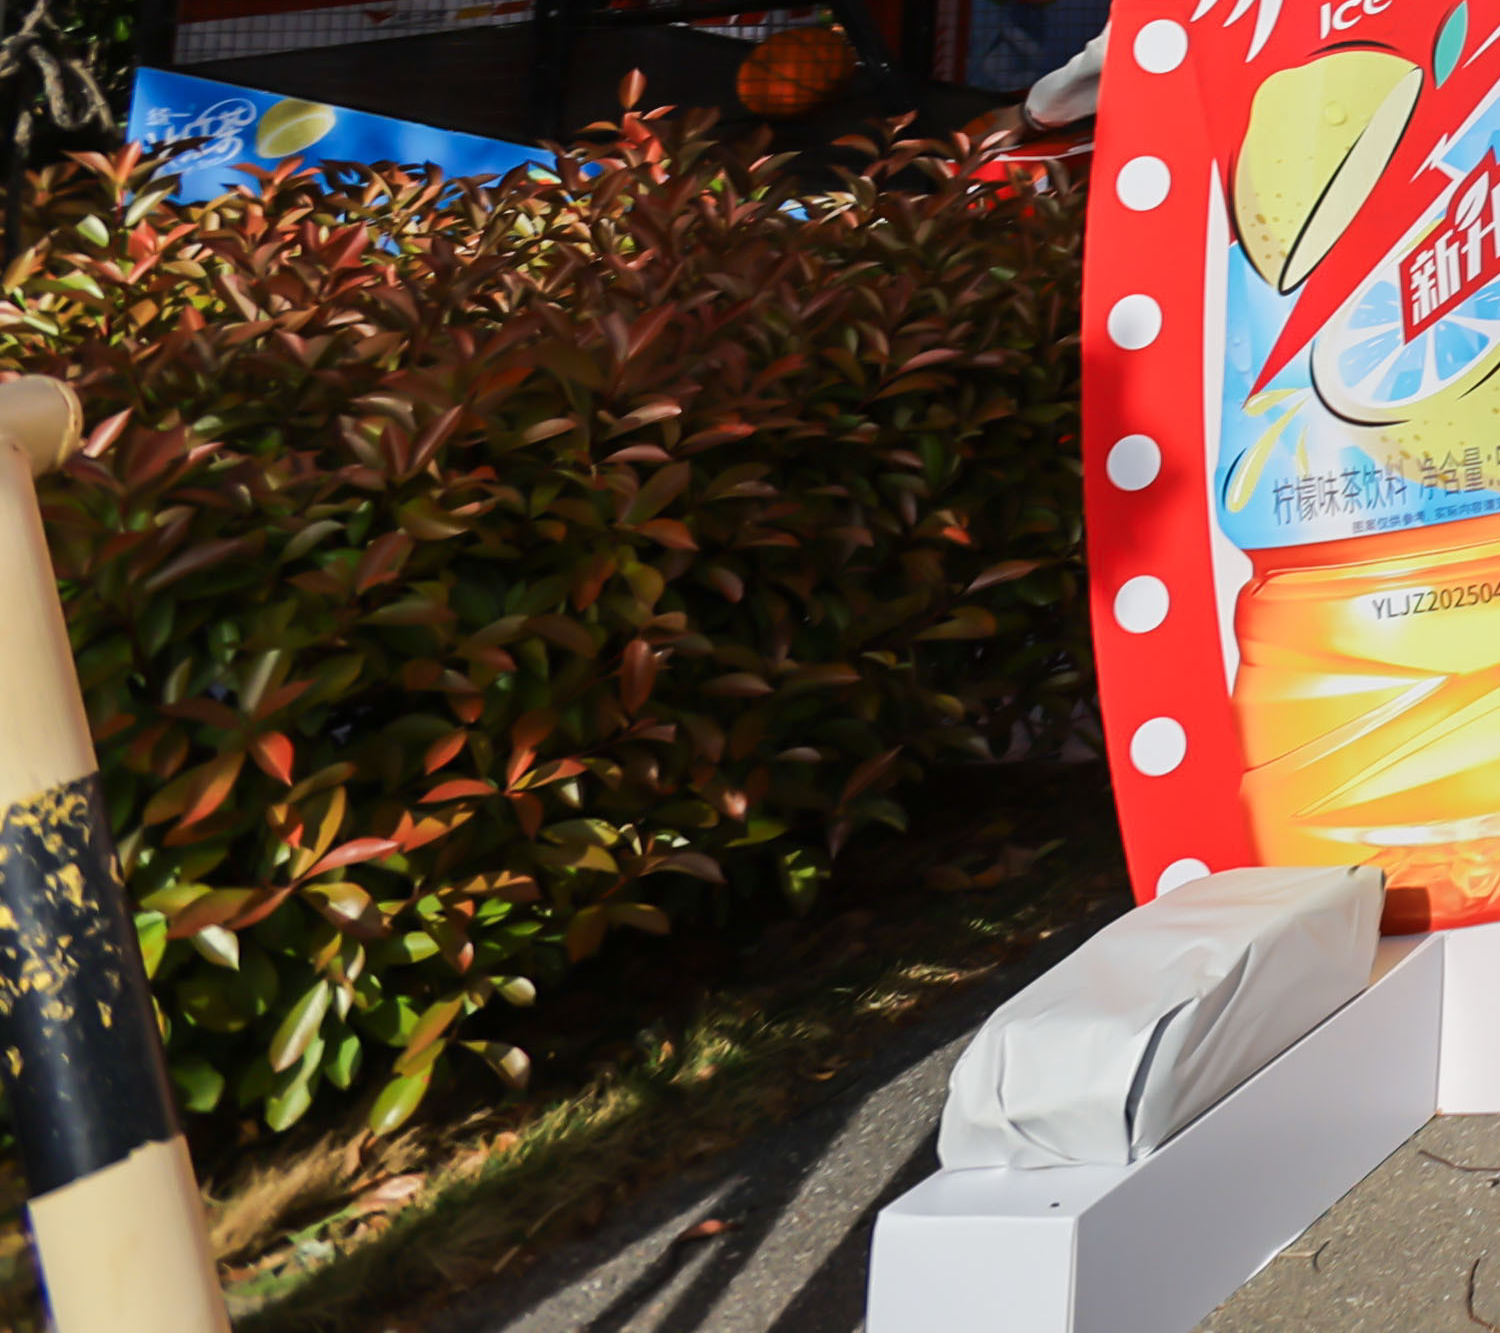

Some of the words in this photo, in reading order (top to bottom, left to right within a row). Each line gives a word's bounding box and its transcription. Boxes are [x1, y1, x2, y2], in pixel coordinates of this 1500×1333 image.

[1273, 469, 1407, 527] 柠檬味茶饮料
